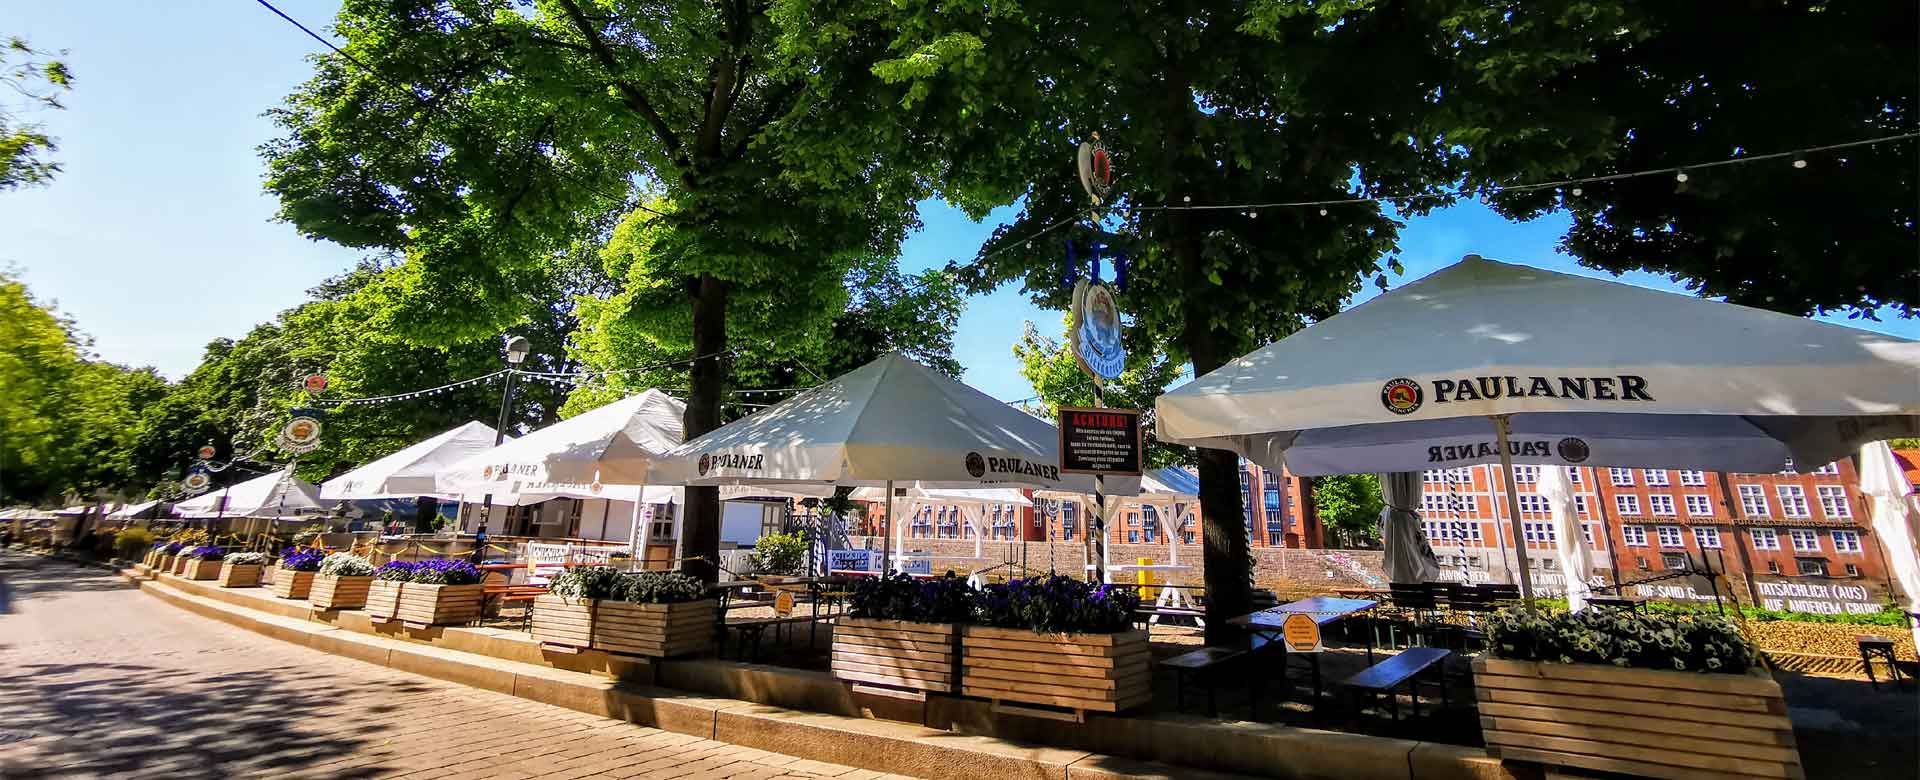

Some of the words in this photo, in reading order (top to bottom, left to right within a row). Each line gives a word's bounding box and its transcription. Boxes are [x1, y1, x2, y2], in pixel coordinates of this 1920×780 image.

[1384, 379, 1420, 394] PAULANER
[1432, 375, 1656, 403] PAULANER
[988, 457, 1060, 481] PAULANER
[1637, 583, 1655, 597] AUF
[1658, 586, 1684, 598] SAND
[1758, 580, 1829, 600] TATSÄCHLICH
[1833, 585, 1867, 601] (AUS)
[1764, 599, 1782, 612] AUF
[1789, 601, 1842, 615] ANDEREM
